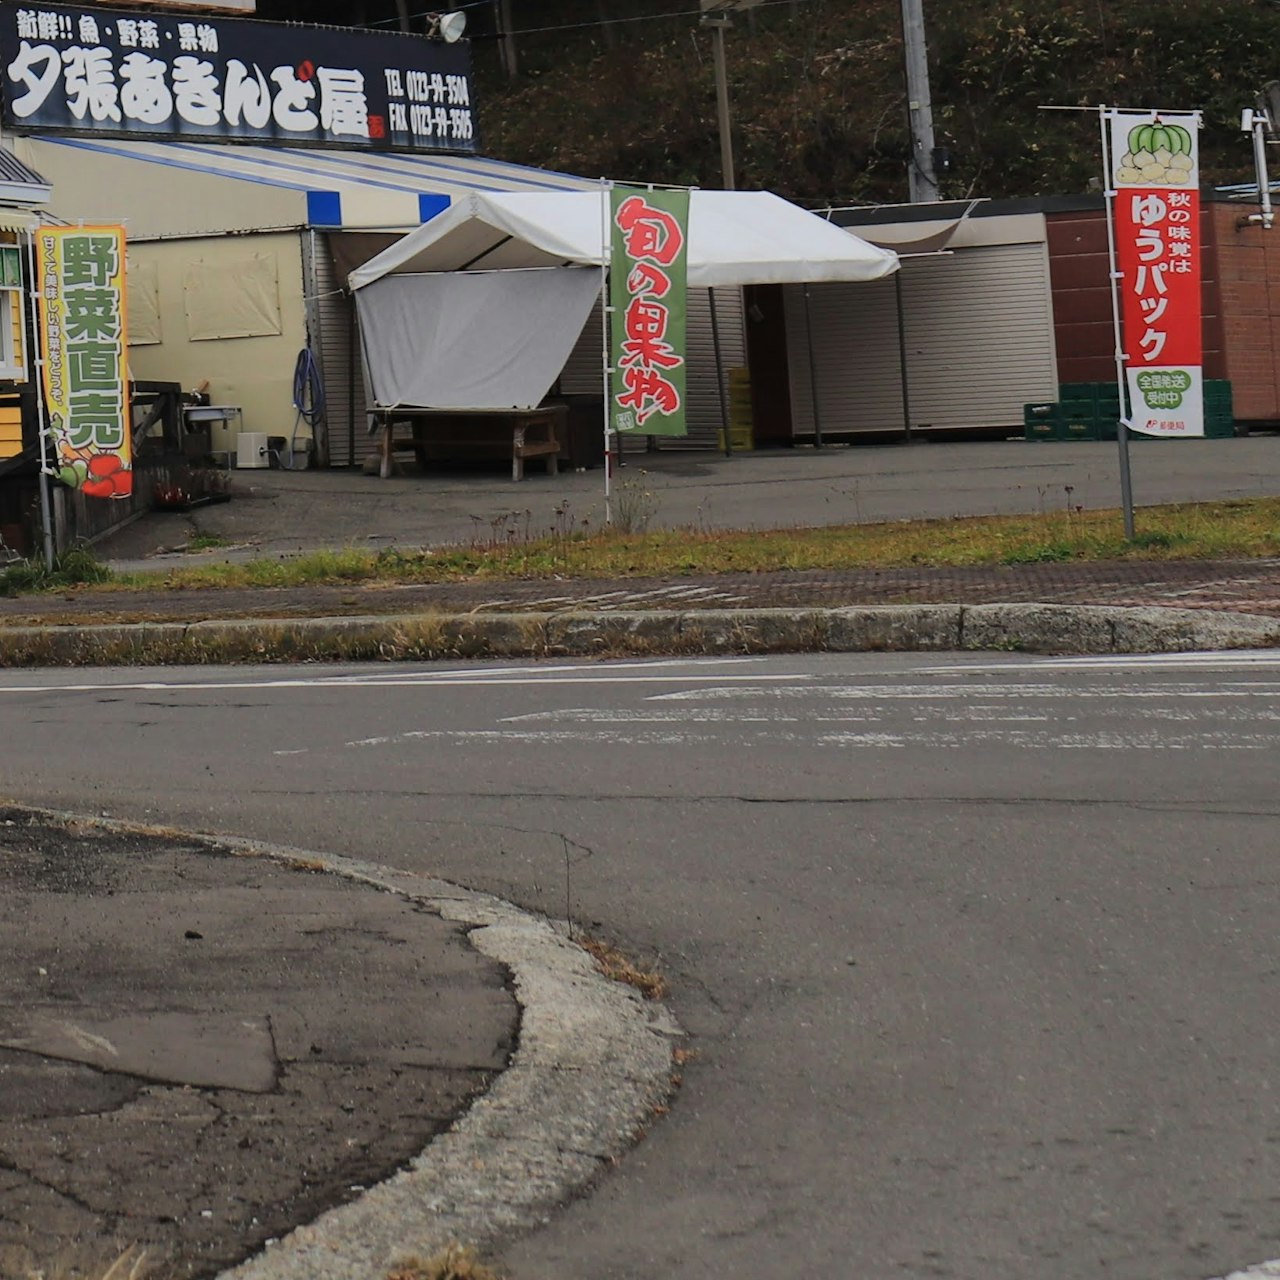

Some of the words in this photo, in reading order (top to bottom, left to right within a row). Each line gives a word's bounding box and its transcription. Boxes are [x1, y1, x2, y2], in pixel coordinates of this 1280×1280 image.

[7, 41, 371, 138] 夕張あきんど屋
[384, 69, 404, 96] TEL
[388, 103, 409, 131] FAX
[1167, 192, 1192, 273] 秋の味覚は
[614, 195, 685, 426] 旬の果物
[1132, 194, 1169, 362] ゆうパック
[61, 235, 124, 449] 野菜直売
[1140, 375, 1186, 390] 全国発送
[1147, 391, 1179, 405] 受付中
